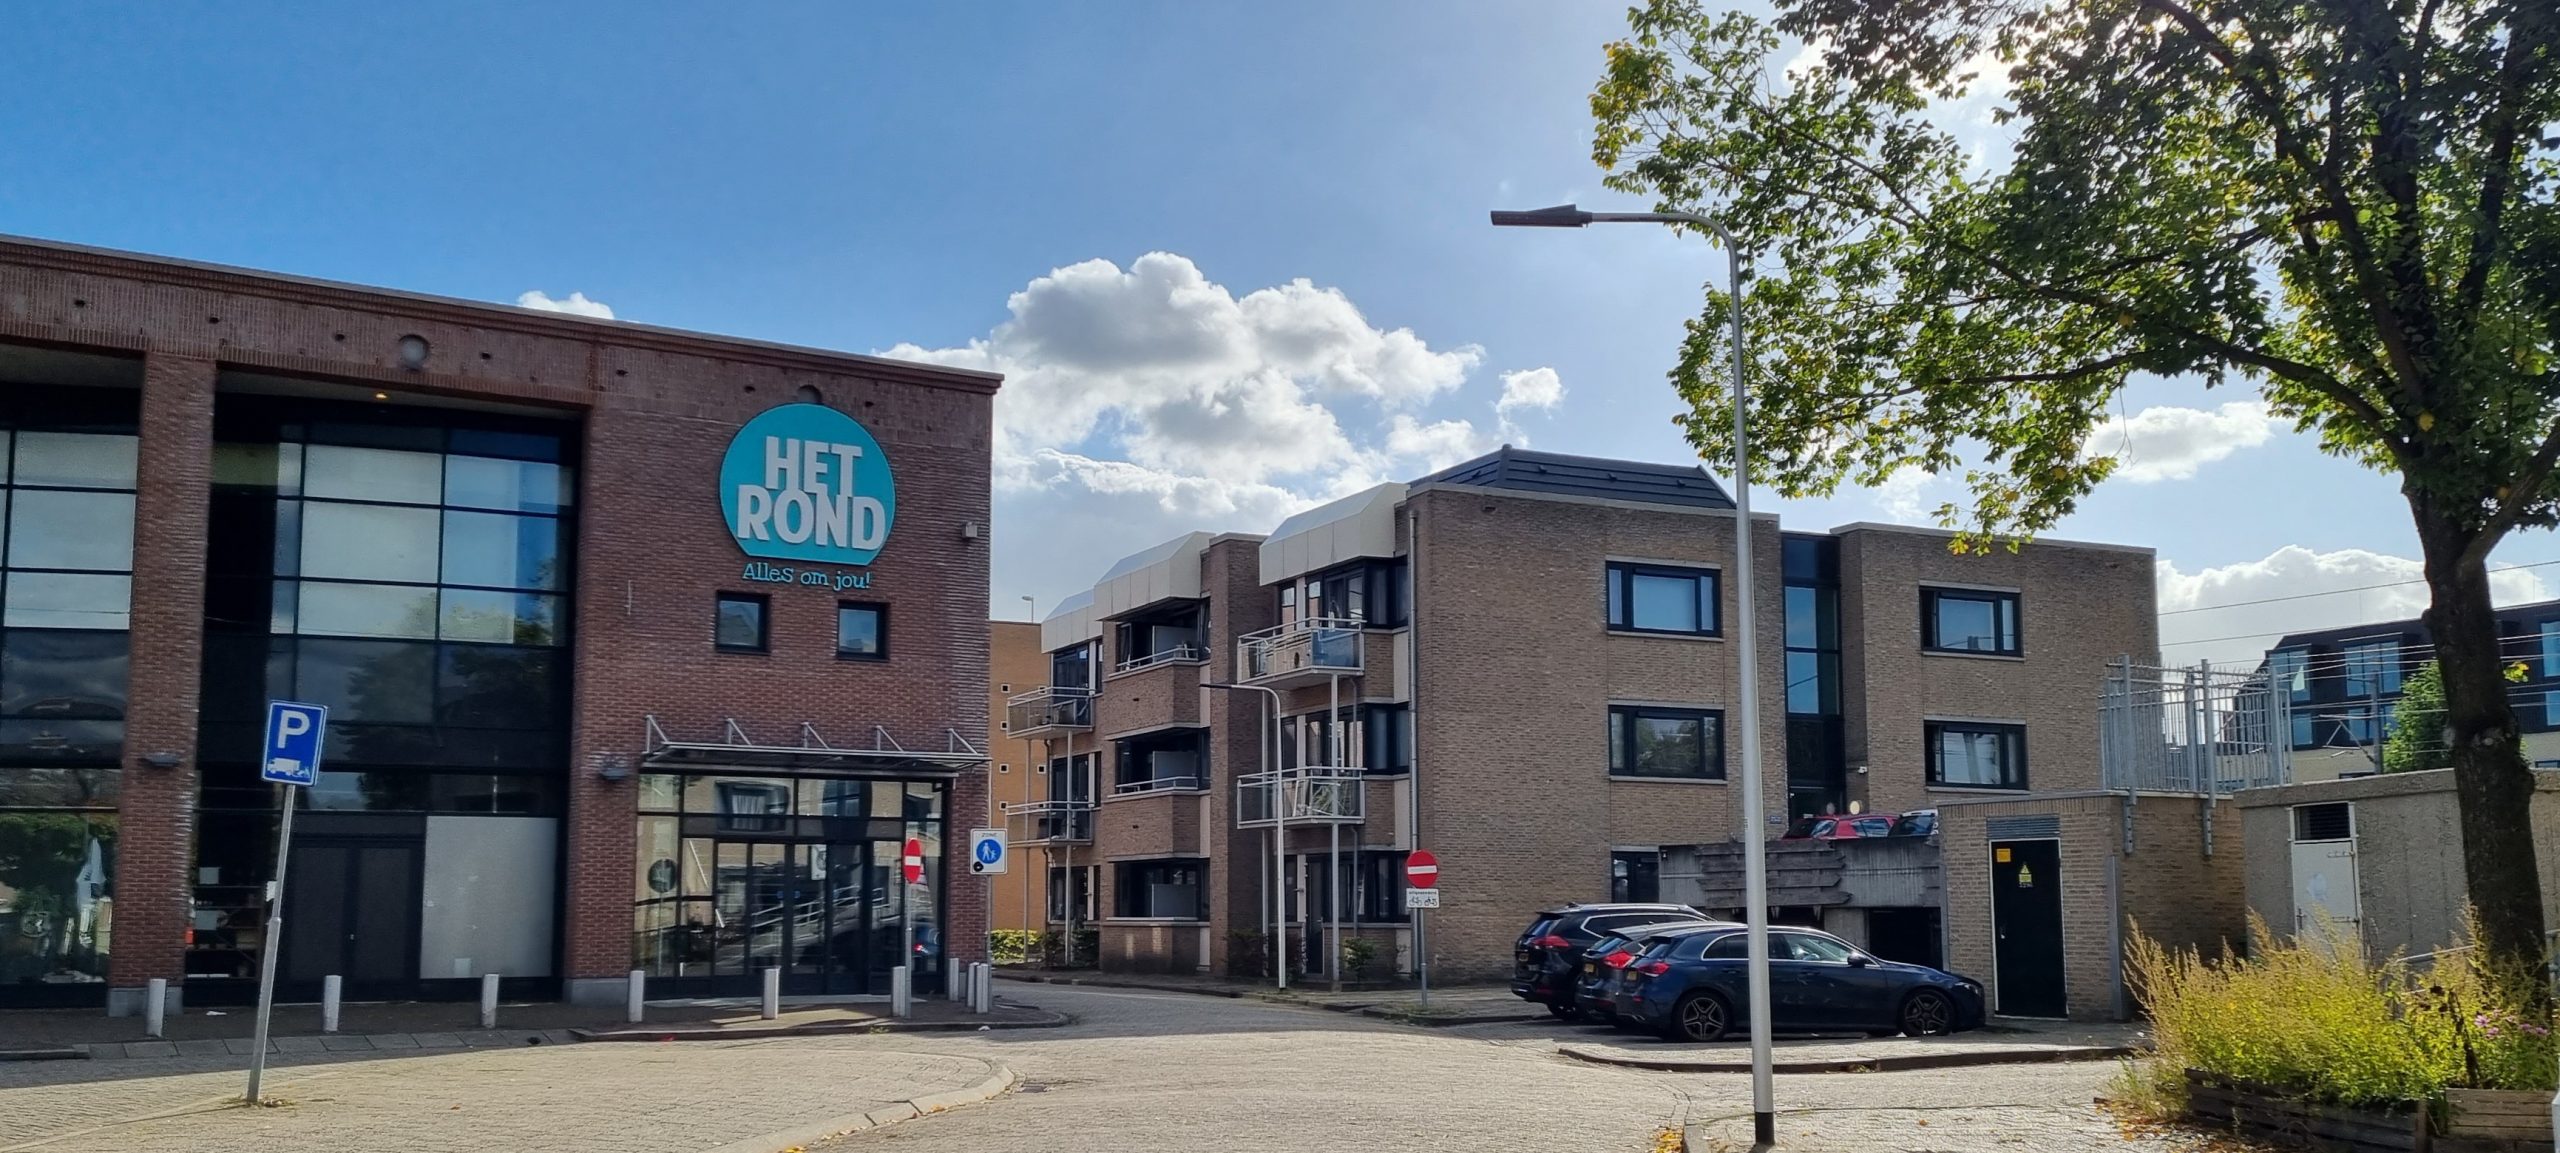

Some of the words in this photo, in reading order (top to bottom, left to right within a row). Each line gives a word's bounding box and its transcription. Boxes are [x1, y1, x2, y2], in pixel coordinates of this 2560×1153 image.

[765, 436, 862, 496] HET
[737, 484, 886, 550] ROND
[742, 562, 794, 583] Alles
[800, 571, 829, 586] om
[833, 570, 871, 591] jou!
[277, 709, 310, 749] P
